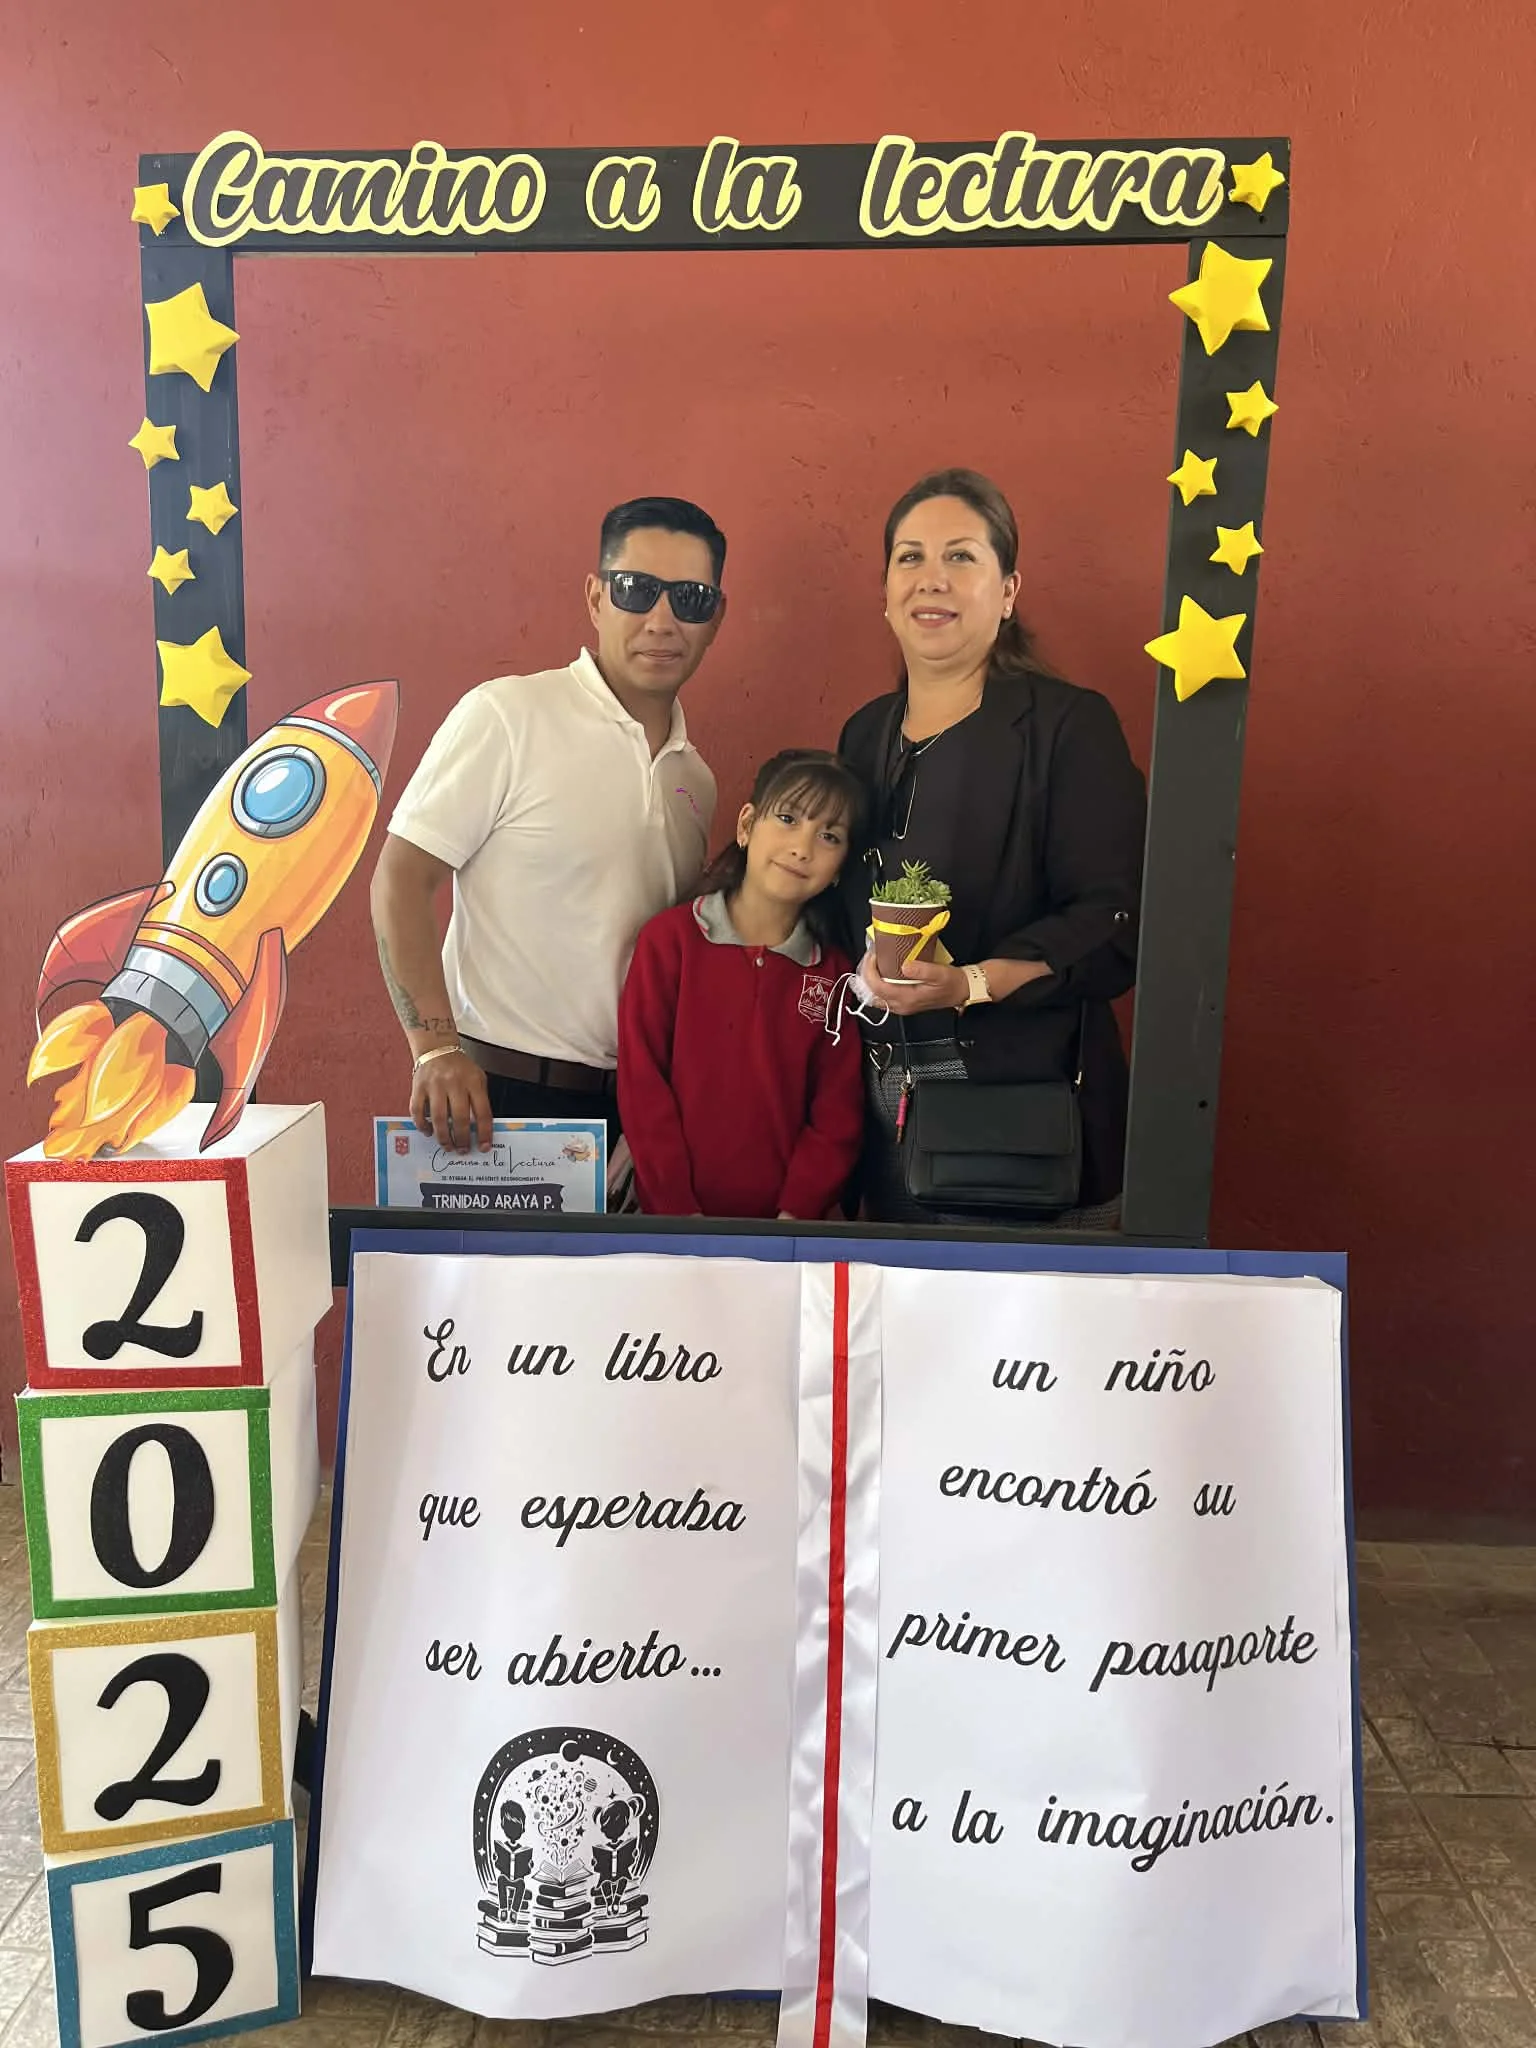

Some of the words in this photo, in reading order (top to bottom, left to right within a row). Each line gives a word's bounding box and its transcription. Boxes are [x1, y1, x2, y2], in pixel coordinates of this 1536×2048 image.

[183, 130, 546, 247] Camino
[586, 156, 660, 231] a
[693, 136, 802, 233] la
[859, 131, 1224, 238] lectura
[431, 1194, 490, 1209] TRINIDAD
[494, 1193, 539, 1209] ARAYA
[543, 1195, 555, 1210] P.
[423, 1318, 471, 1382] En
[507, 1344, 574, 1376] un
[604, 1332, 722, 1382] libro
[992, 1358, 1057, 1392] un
[1104, 1349, 1215, 1392] niño
[419, 1493, 480, 1541] que
[520, 1487, 746, 1548] esperaba
[939, 1465, 1157, 1516] encontró
[1193, 1482, 1237, 1517] su
[425, 1639, 482, 1681] ser
[507, 1630, 721, 1687] abierto...
[886, 1611, 1066, 1673] primer
[1089, 1615, 1318, 1693] pasaporte
[892, 1797, 928, 1832] a
[951, 1790, 1004, 1844] la
[1037, 1781, 1335, 1873] imaginación.
